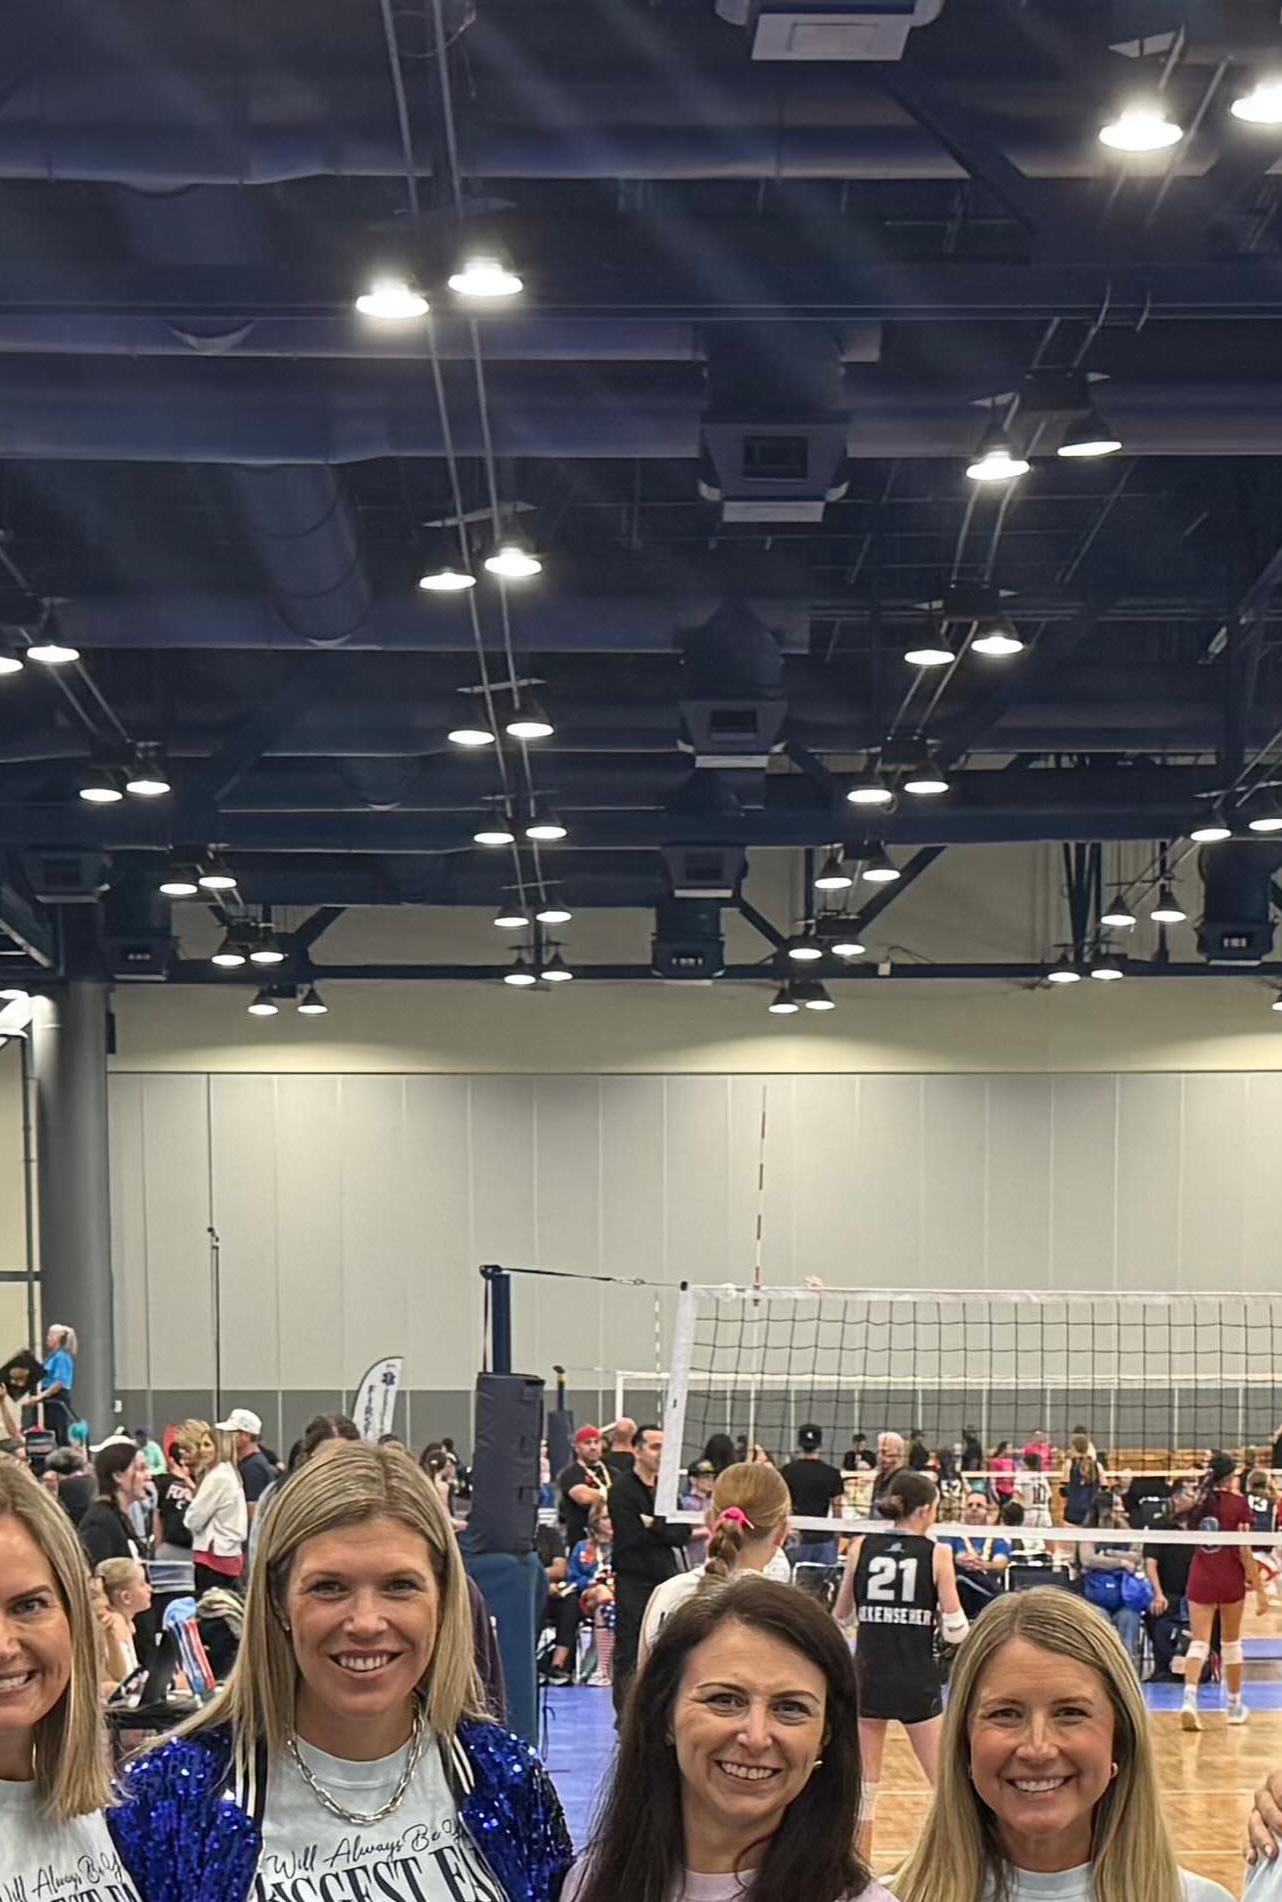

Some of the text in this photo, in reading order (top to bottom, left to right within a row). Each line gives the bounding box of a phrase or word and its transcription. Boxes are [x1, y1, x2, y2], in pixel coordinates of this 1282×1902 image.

[867, 1556, 918, 1602] 21
[266, 1845, 317, 1879] Will
[322, 1834, 403, 1868] Always
[402, 1823, 441, 1852] Be
